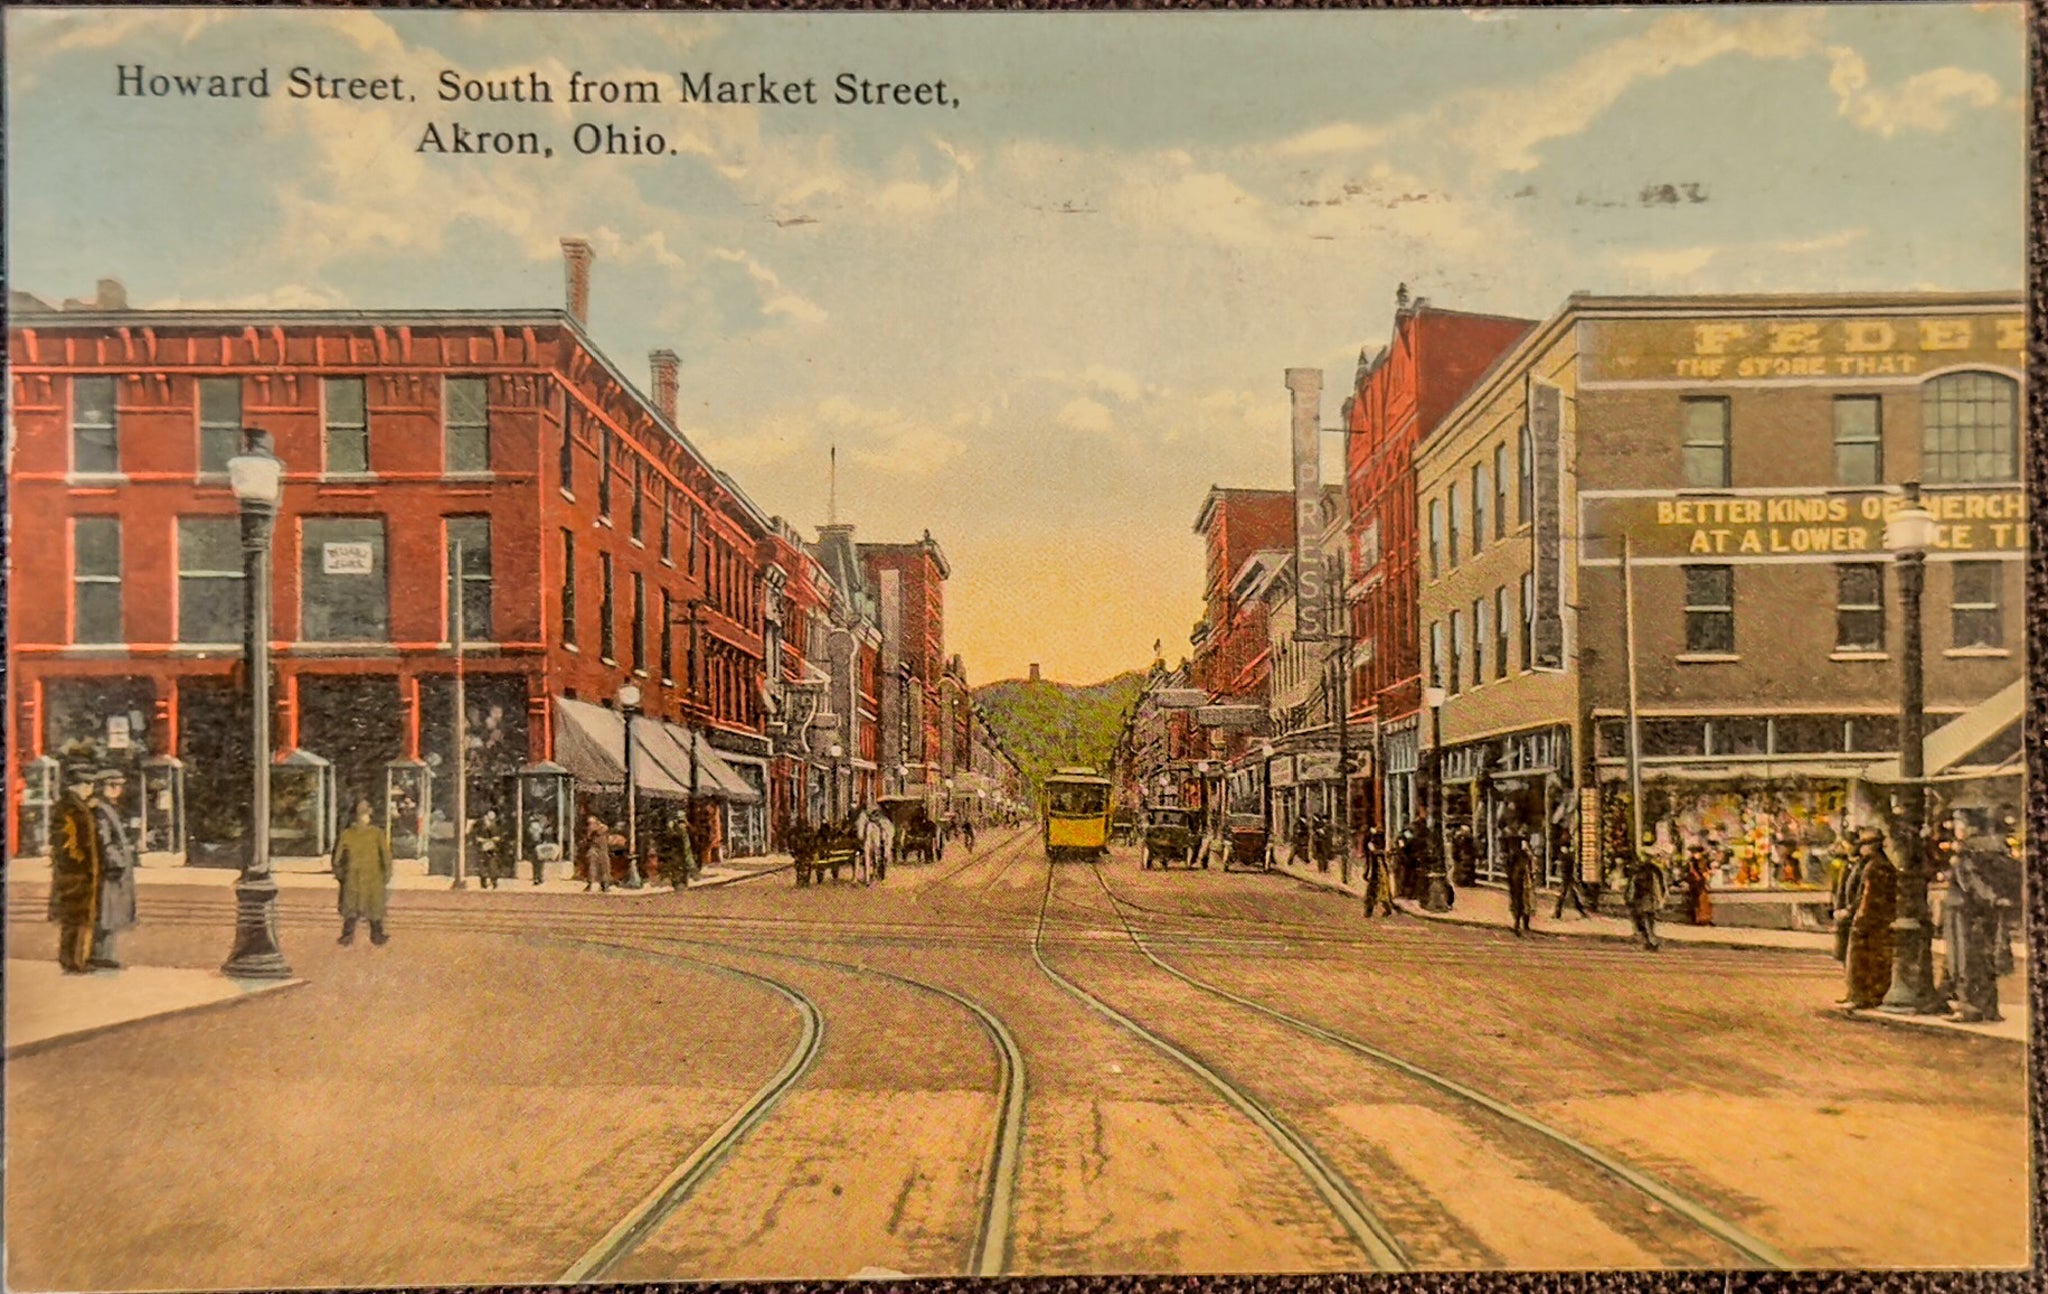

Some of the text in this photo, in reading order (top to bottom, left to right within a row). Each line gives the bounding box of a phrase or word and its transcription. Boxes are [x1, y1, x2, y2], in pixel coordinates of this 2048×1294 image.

[1674, 353, 1916, 377] THE STORE THAT
[1657, 500, 1762, 525] BETTER
[1766, 497, 1848, 523] KINDS
[1689, 529, 1731, 553] AT
[1739, 529, 1763, 553] A
[1769, 526, 1868, 553] LOWER
